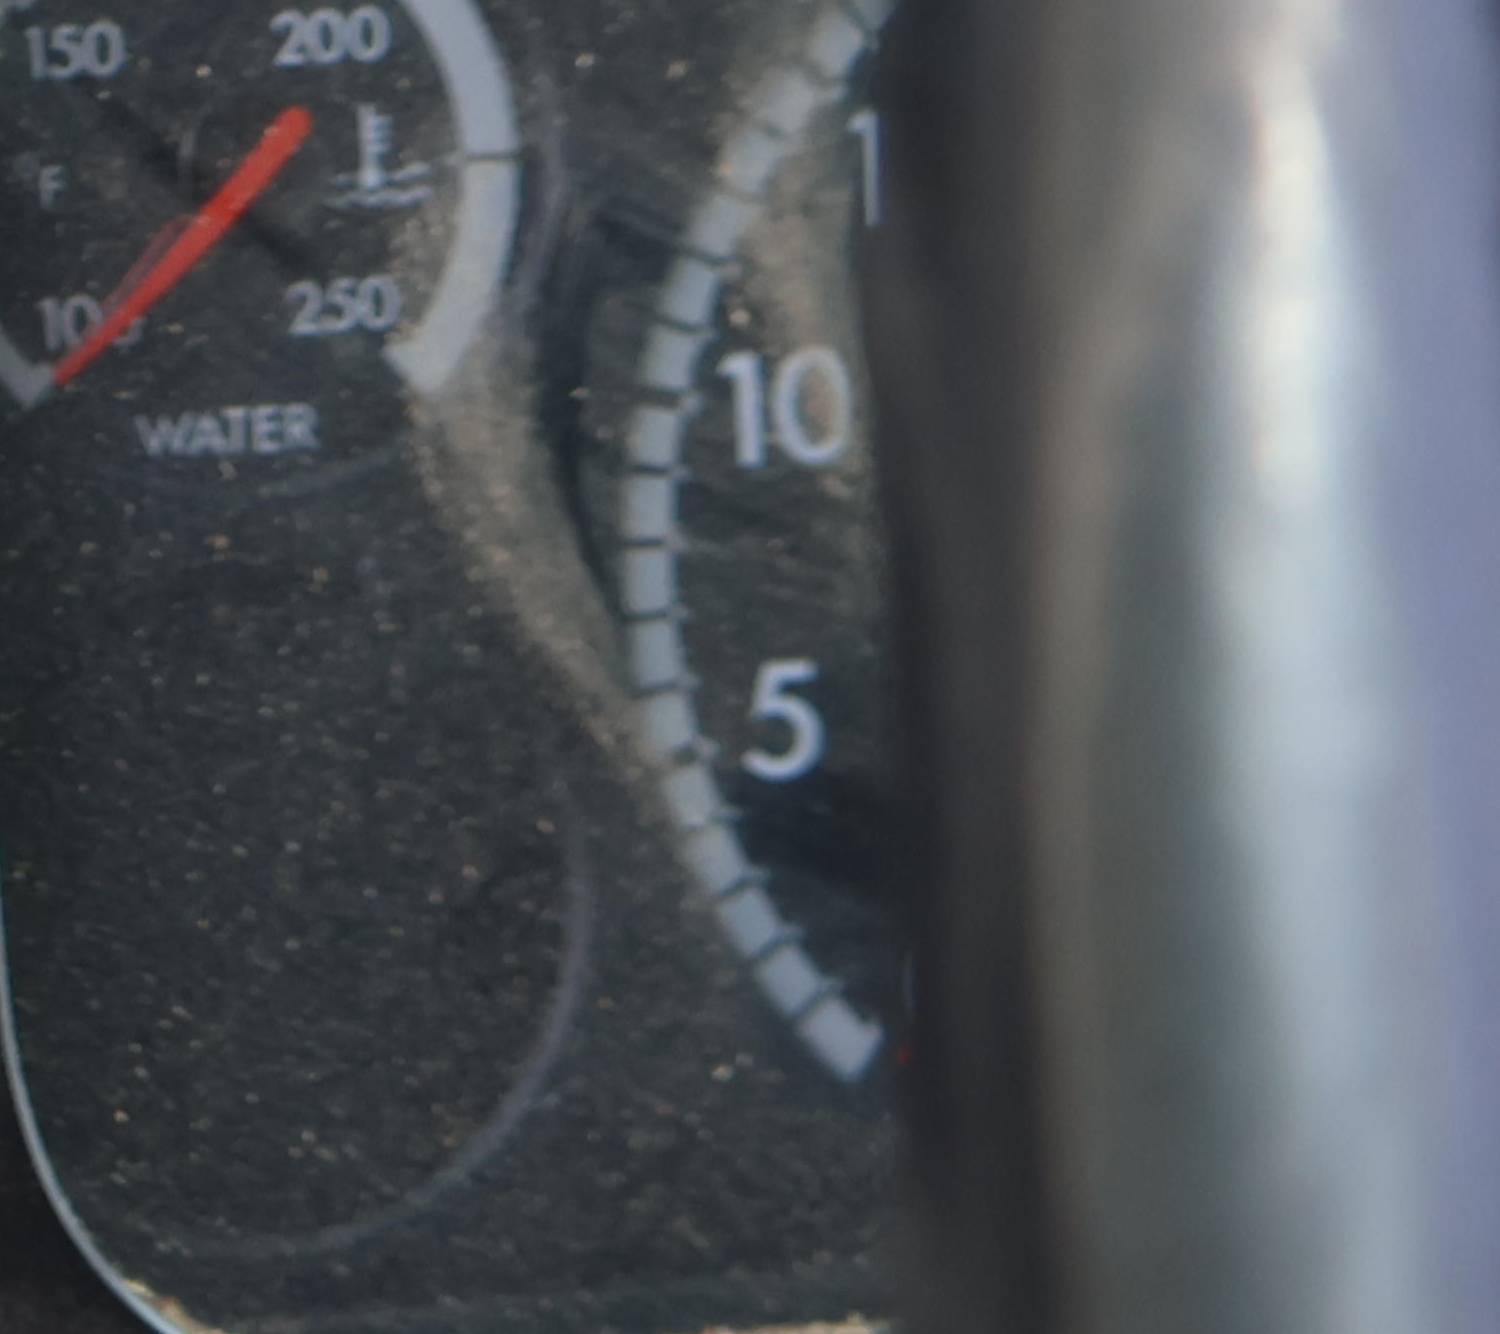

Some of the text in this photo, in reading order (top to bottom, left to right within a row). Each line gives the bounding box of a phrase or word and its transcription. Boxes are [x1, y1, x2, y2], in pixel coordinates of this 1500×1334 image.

[26, 19, 127, 80] 150
[269, 6, 392, 67] 200
[847, 107, 881, 227] 1
[284, 275, 404, 337] 250
[134, 402, 320, 458] WATER
[716, 344, 853, 467] 10
[742, 658, 826, 783] 5
